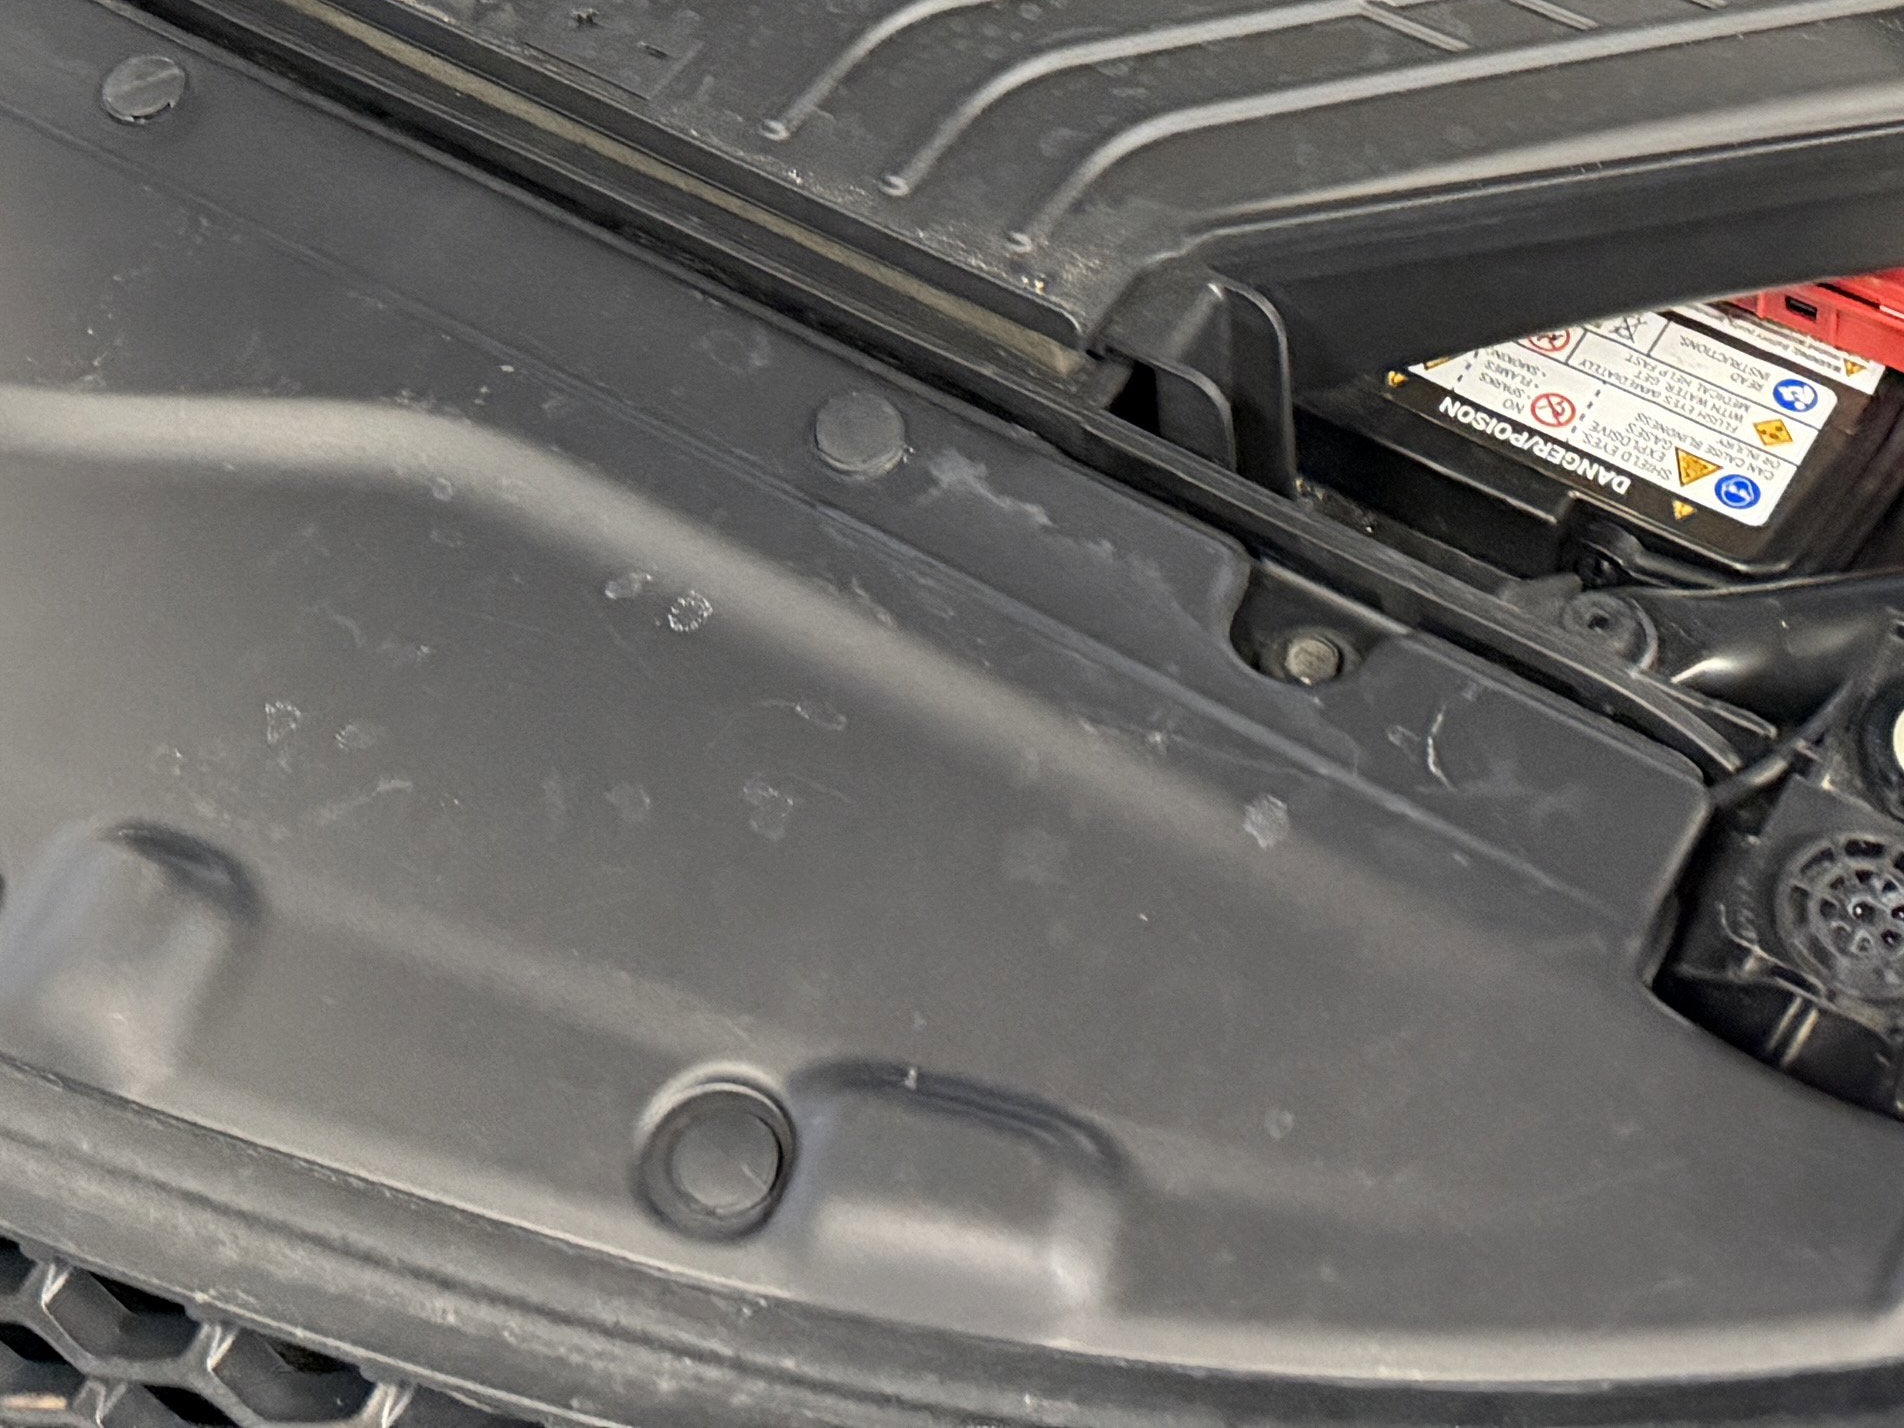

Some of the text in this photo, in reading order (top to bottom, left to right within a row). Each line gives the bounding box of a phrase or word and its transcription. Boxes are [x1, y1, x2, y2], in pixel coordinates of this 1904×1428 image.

[1482, 358, 1534, 387] FLAMES
[1485, 345, 1541, 375] SMOKIN
[1477, 371, 1525, 398] SPARKS
[1633, 368, 1660, 386] GET
[1657, 365, 1693, 387] HELP
[1729, 370, 1764, 392] READ
[1500, 397, 1525, 414] NO
[1578, 357, 1739, 433] FLUSH EYES IMMEDIATELY
[1694, 382, 1751, 413] MEDICAL
[1709, 402, 1744, 423] WITH
[1439, 396, 1632, 494] DANGER/POISON
[1587, 419, 1667, 462] EXPLOSIVE
[1624, 421, 1673, 450] GASES
[1633, 411, 1775, 481] CAN CAUSE BLINDNESS
[1619, 449, 1673, 481] SHIELD
